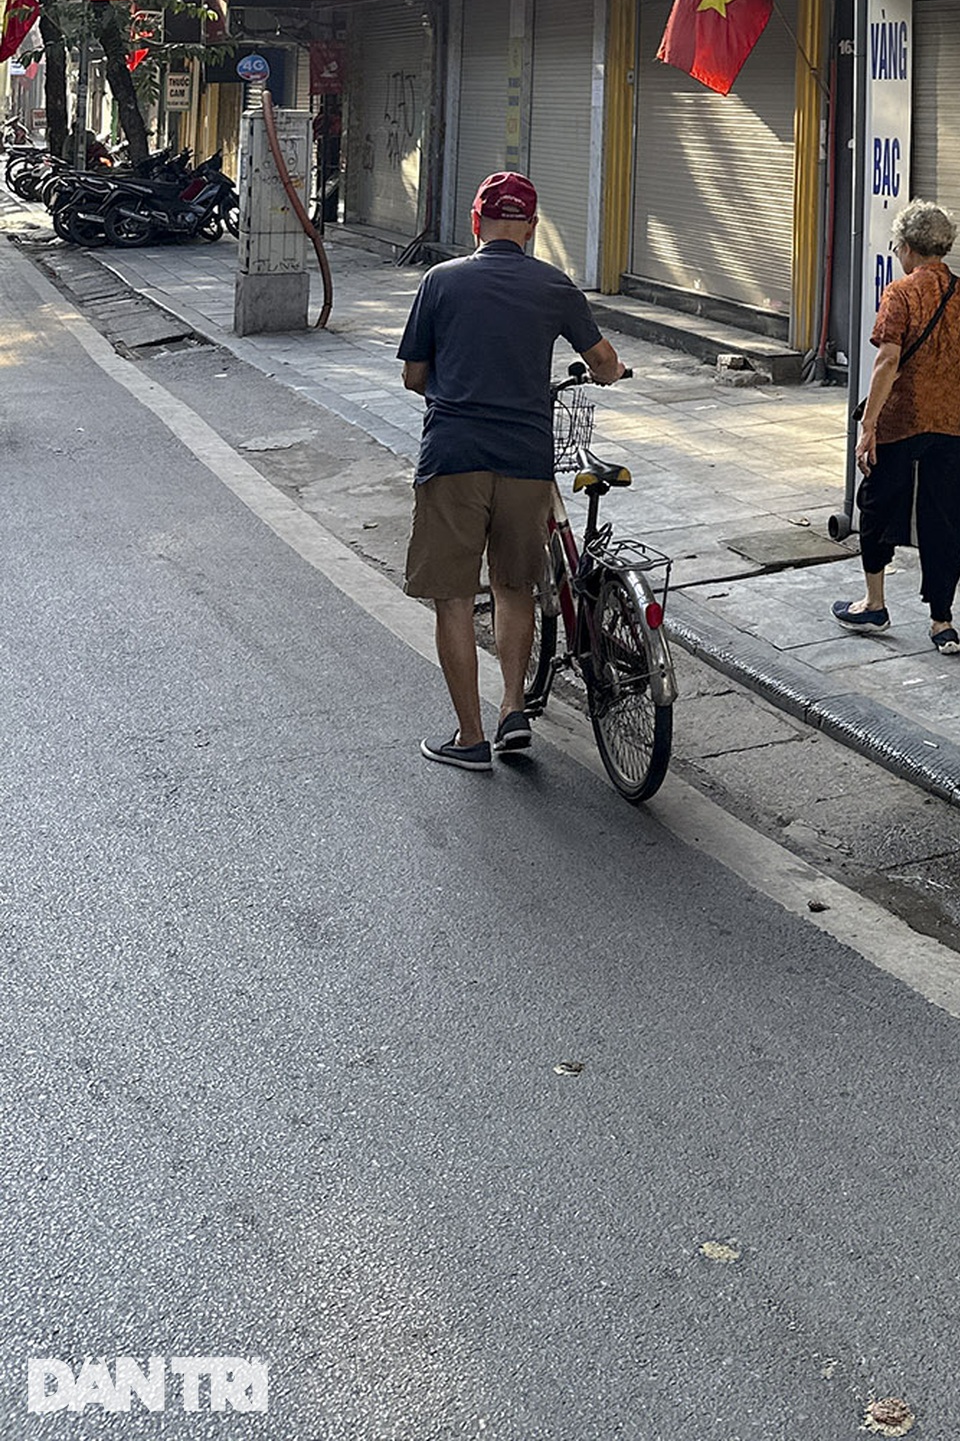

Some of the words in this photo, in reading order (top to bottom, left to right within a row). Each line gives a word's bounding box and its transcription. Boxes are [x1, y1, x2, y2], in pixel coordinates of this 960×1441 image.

[242, 59, 265, 71] 4G
[838, 39, 854, 55] 16
[870, 8, 907, 80] VÀNG
[872, 137, 900, 209] BẠC
